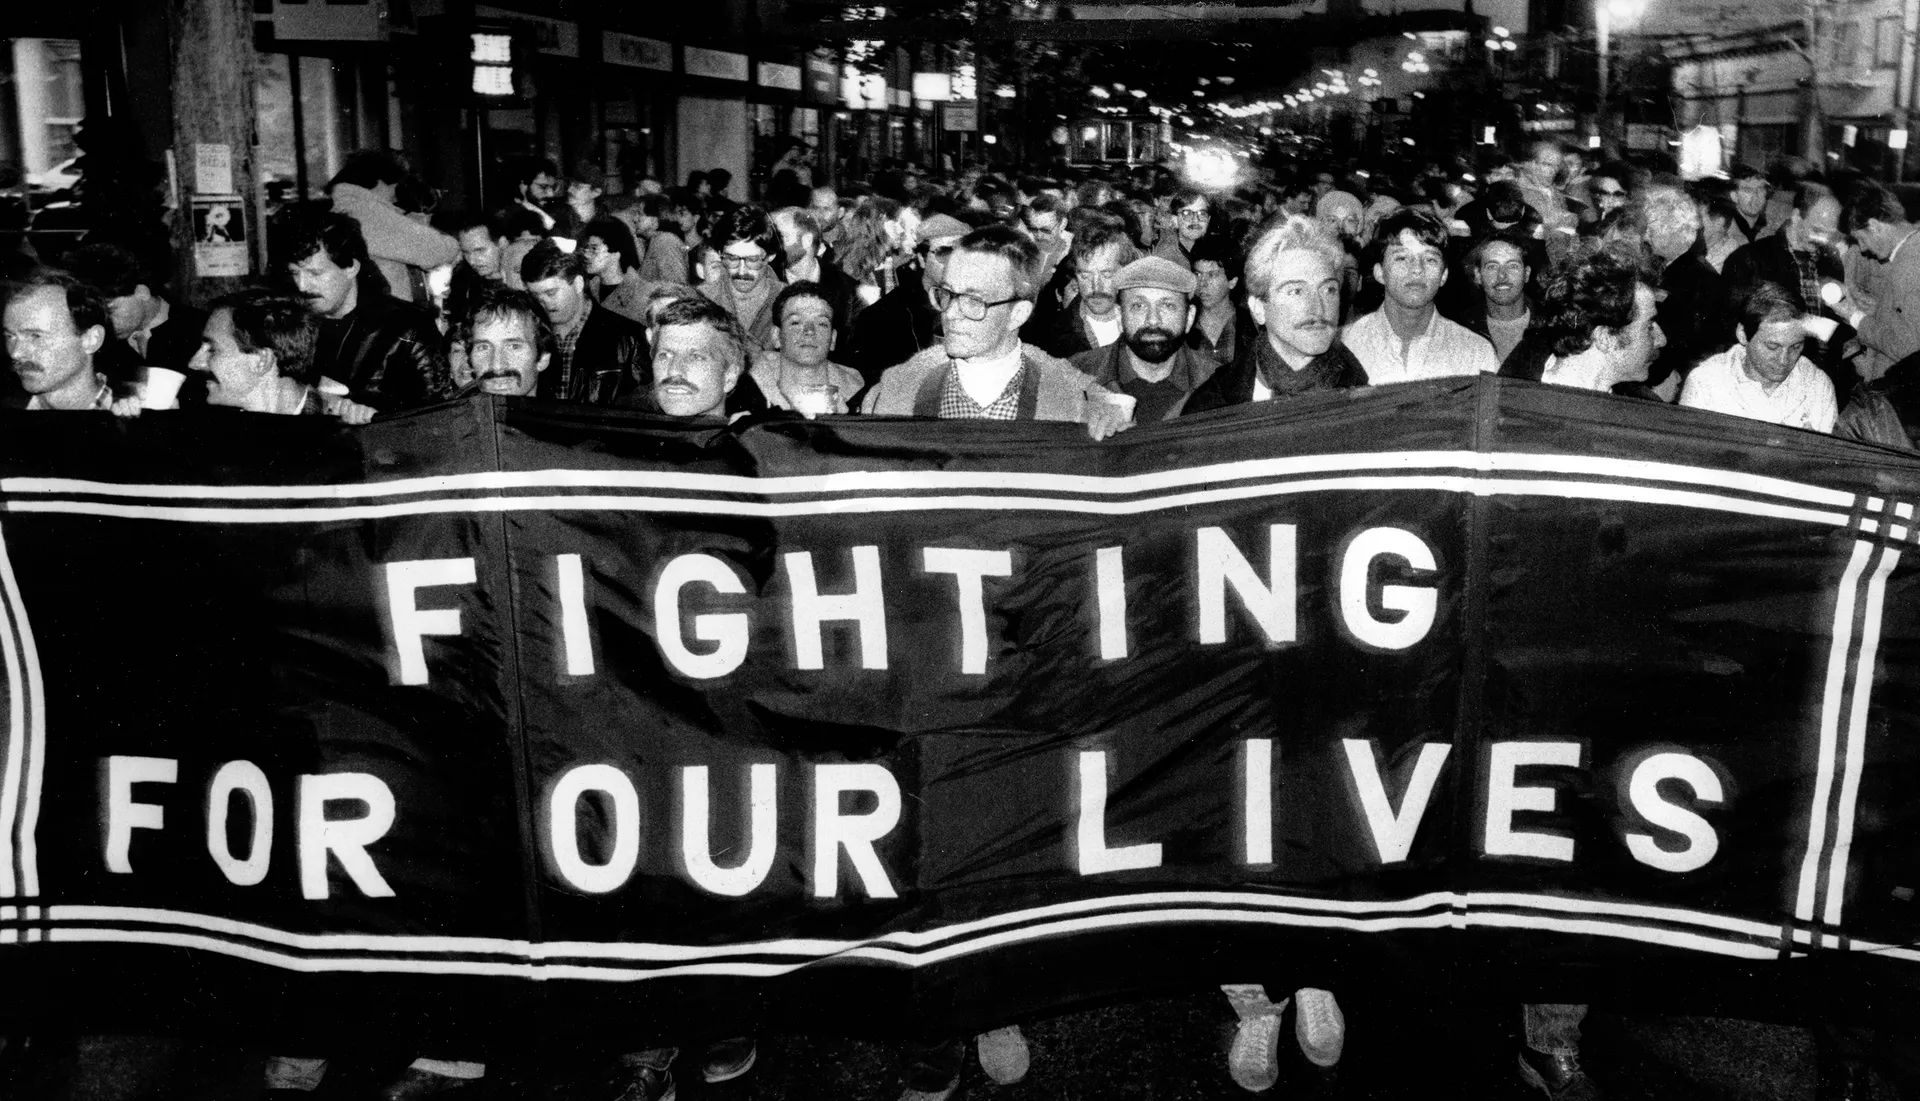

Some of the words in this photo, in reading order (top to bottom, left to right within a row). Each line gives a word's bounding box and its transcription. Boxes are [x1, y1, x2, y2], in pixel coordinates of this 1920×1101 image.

[384, 523, 1438, 686] FIGHTING
[104, 755, 397, 900] FOR
[548, 762, 902, 899] OUR
[1076, 738, 1724, 876] LIVES
